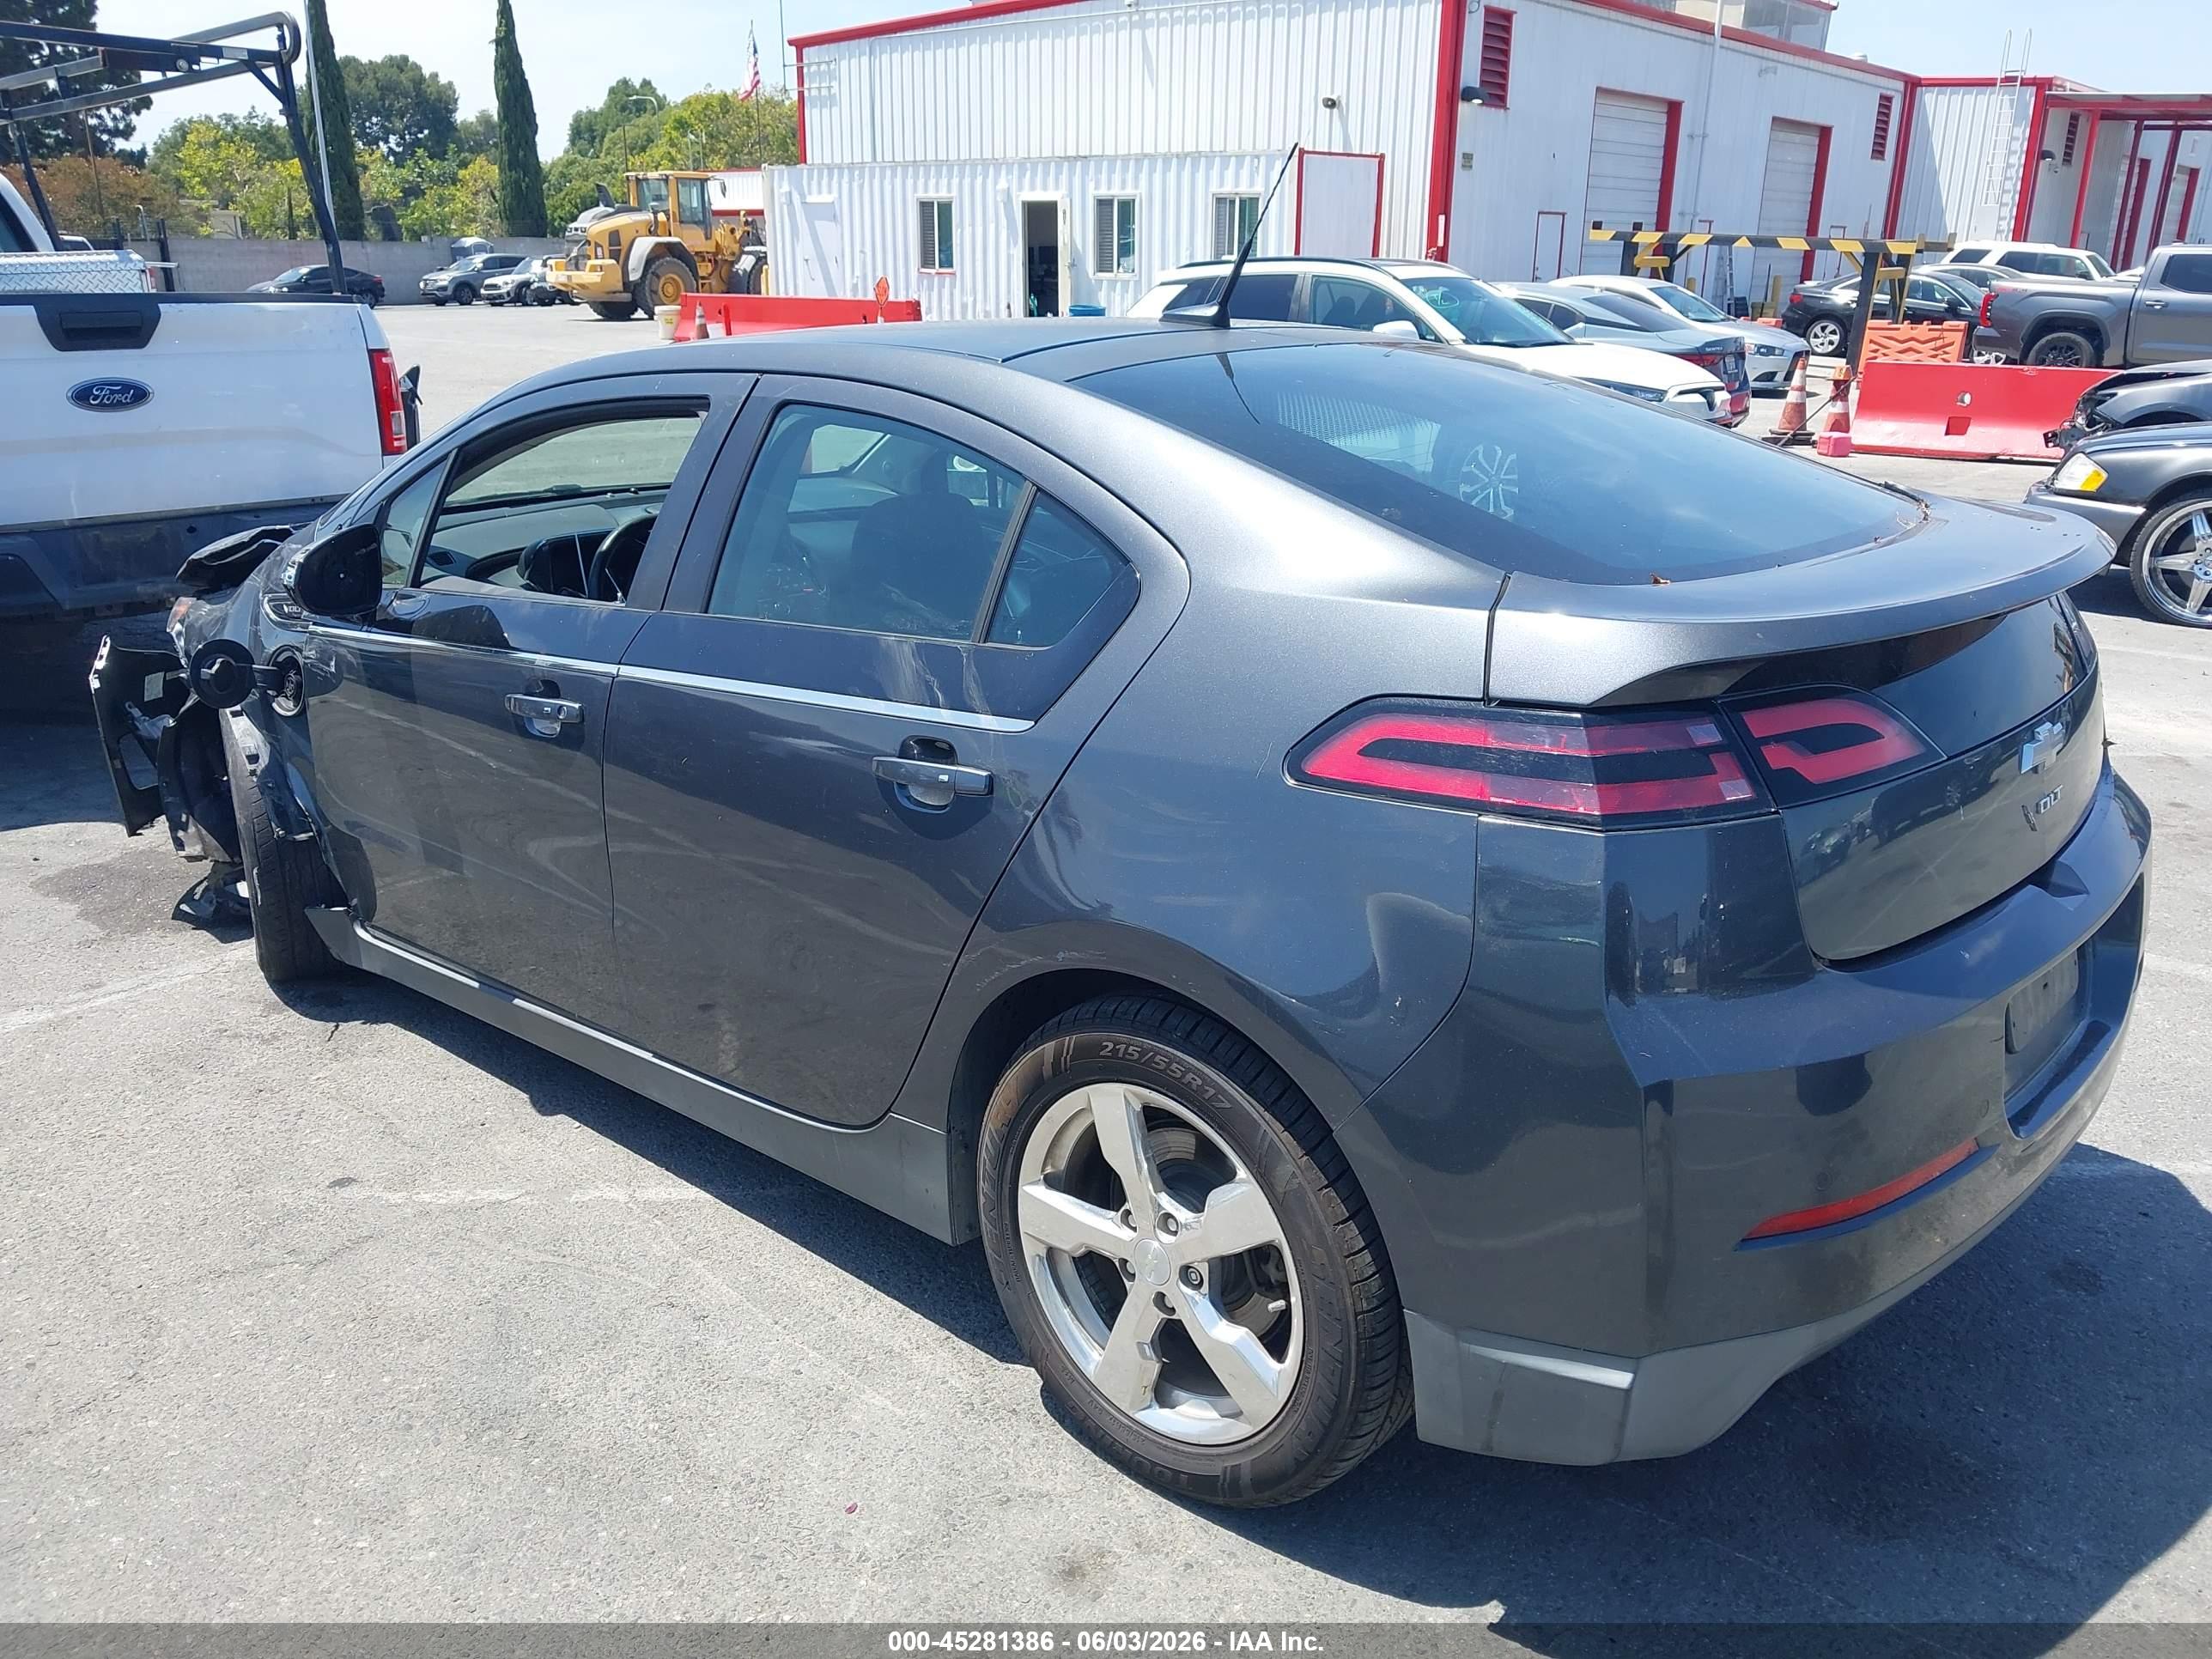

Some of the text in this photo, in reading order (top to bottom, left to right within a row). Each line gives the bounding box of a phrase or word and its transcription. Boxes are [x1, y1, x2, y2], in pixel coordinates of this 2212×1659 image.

[89, 385, 134, 405] Ford
[2021, 783, 2063, 831] VOLT
[1098, 1041, 1233, 1109] 215/55R17
